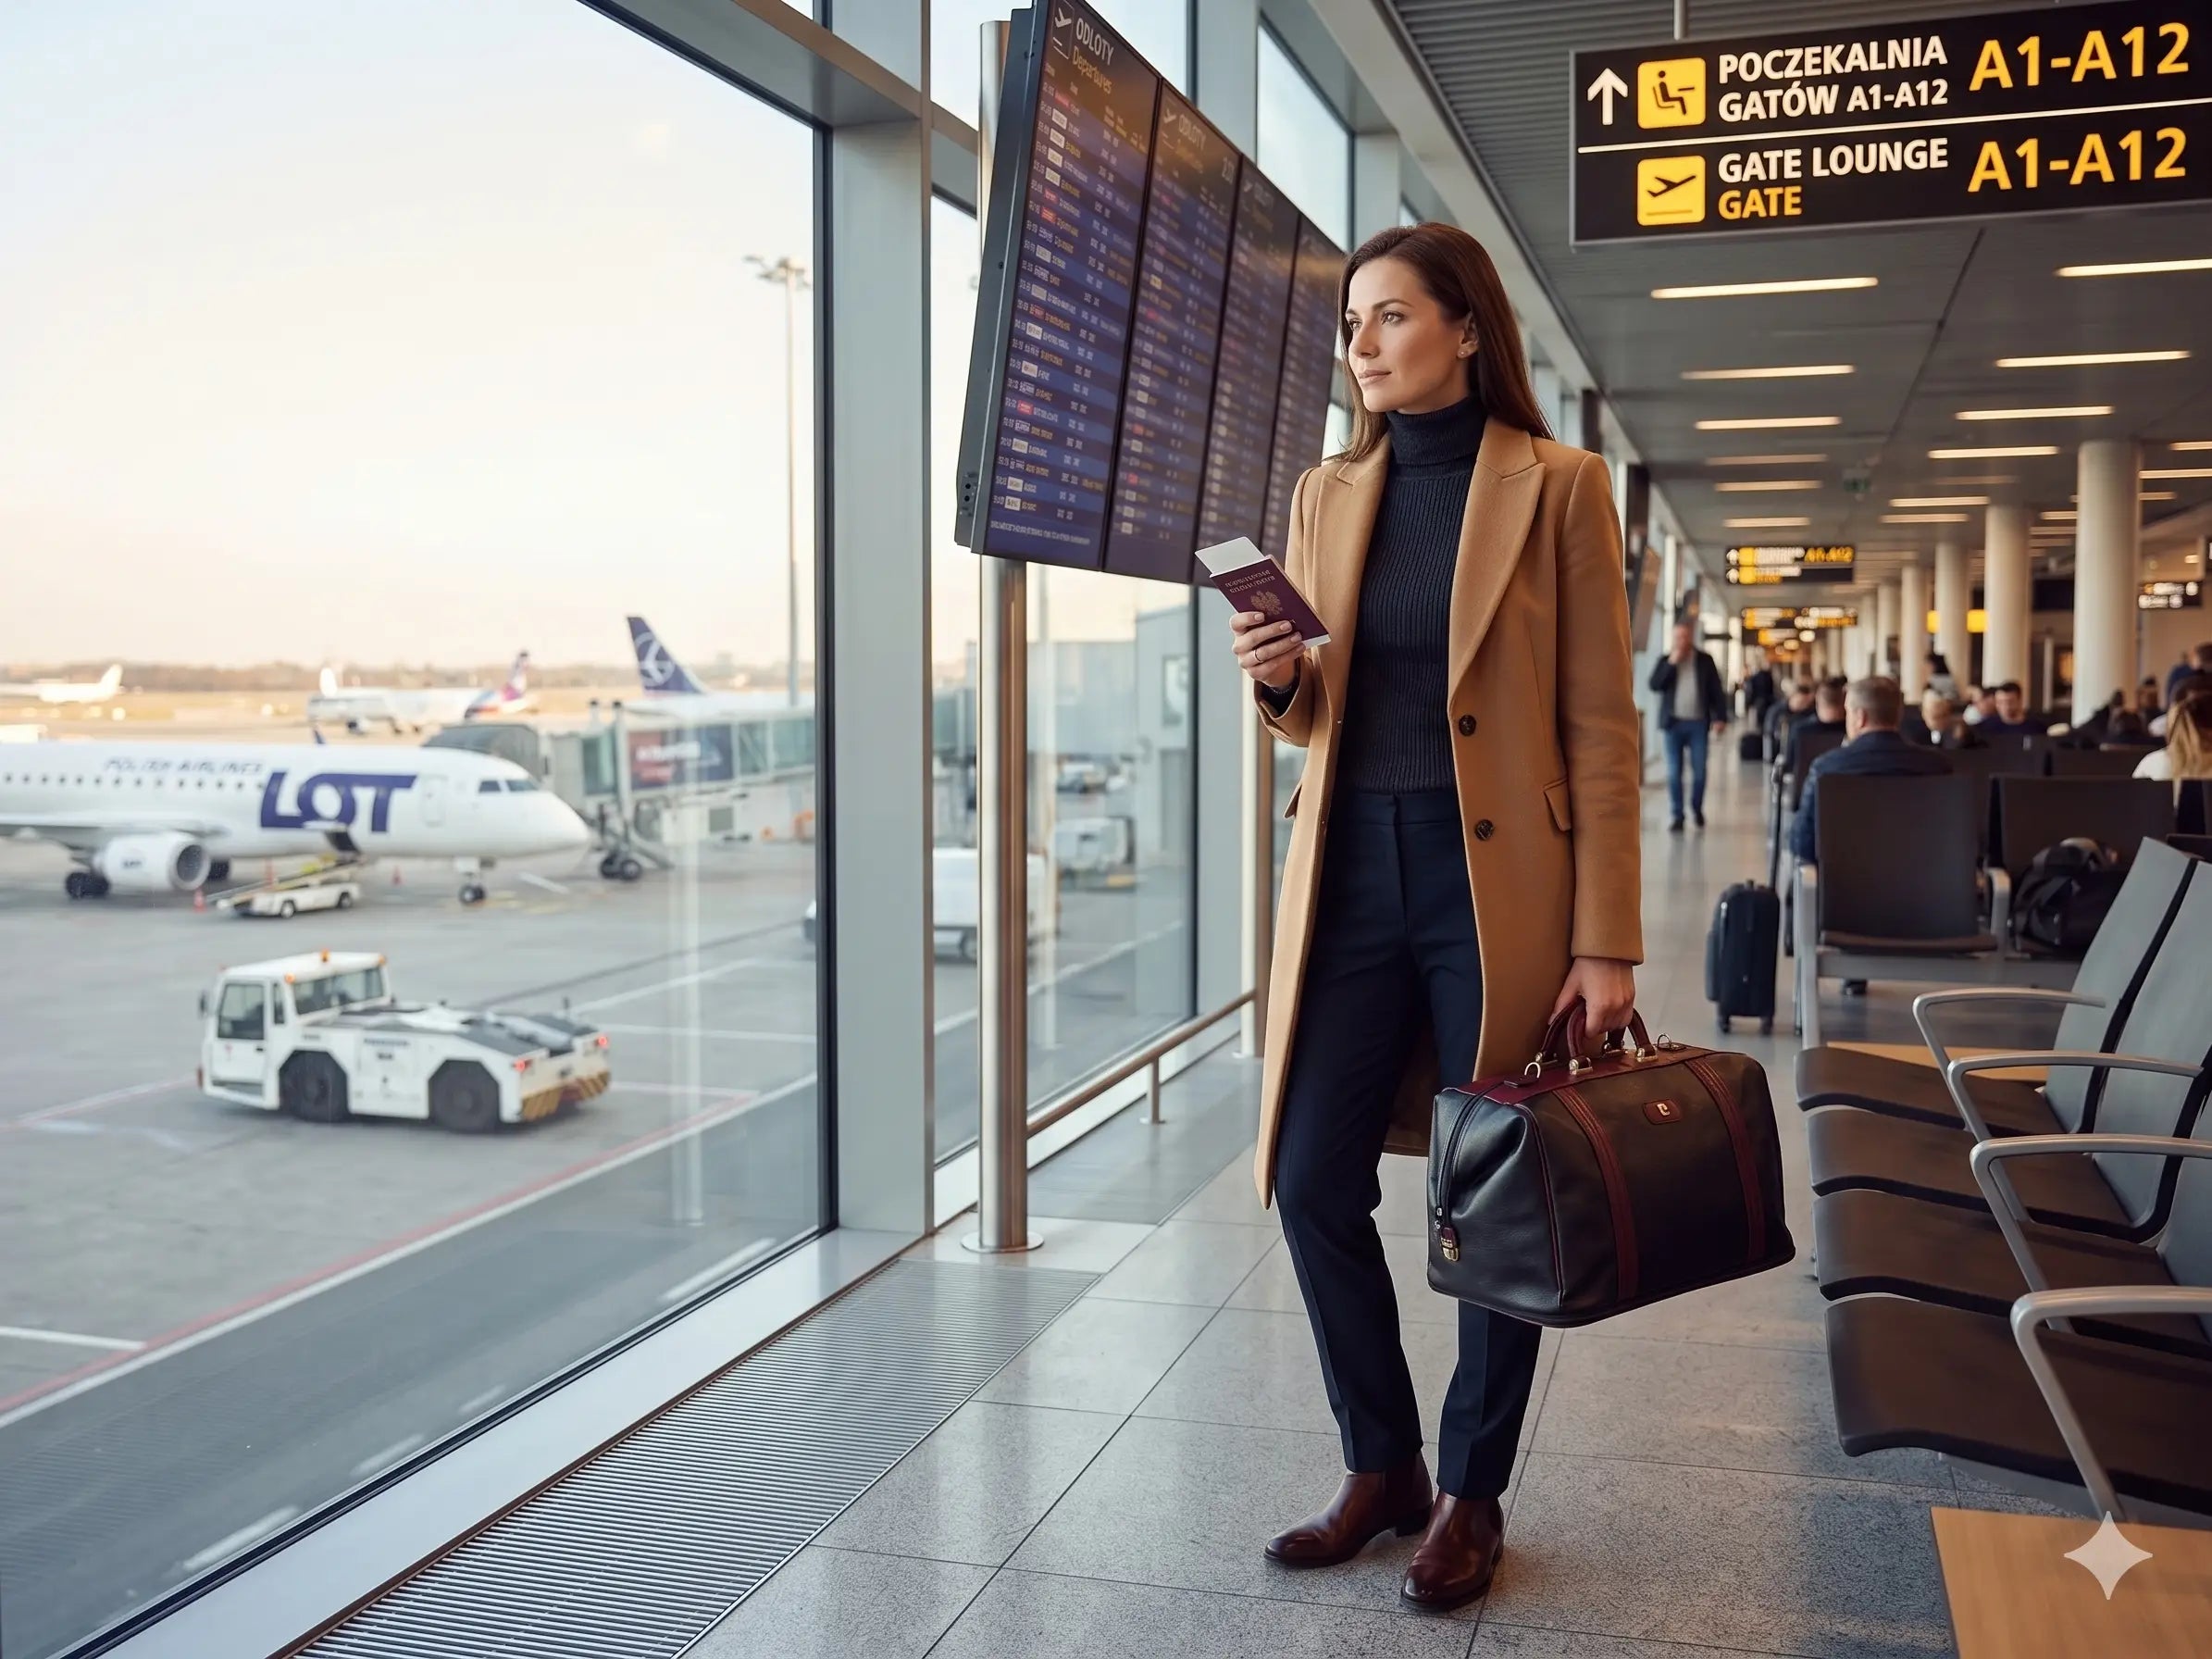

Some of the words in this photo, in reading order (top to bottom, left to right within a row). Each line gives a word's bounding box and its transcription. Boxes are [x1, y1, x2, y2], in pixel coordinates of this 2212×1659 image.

[1075, 17, 1114, 67] ODLOTY
[1719, 34, 1948, 84] POCZEKALNIA
[1968, 21, 2191, 92] A1-A12
[1718, 80, 1840, 123] GATÓW
[1845, 78, 1949, 112] A1-A12
[1718, 148, 1803, 183] GATE
[1811, 137, 1949, 178] LOUNGE
[1967, 126, 2187, 193] A1-A12
[1718, 185, 1803, 220] GATE
[260, 772, 417, 833] LOT
